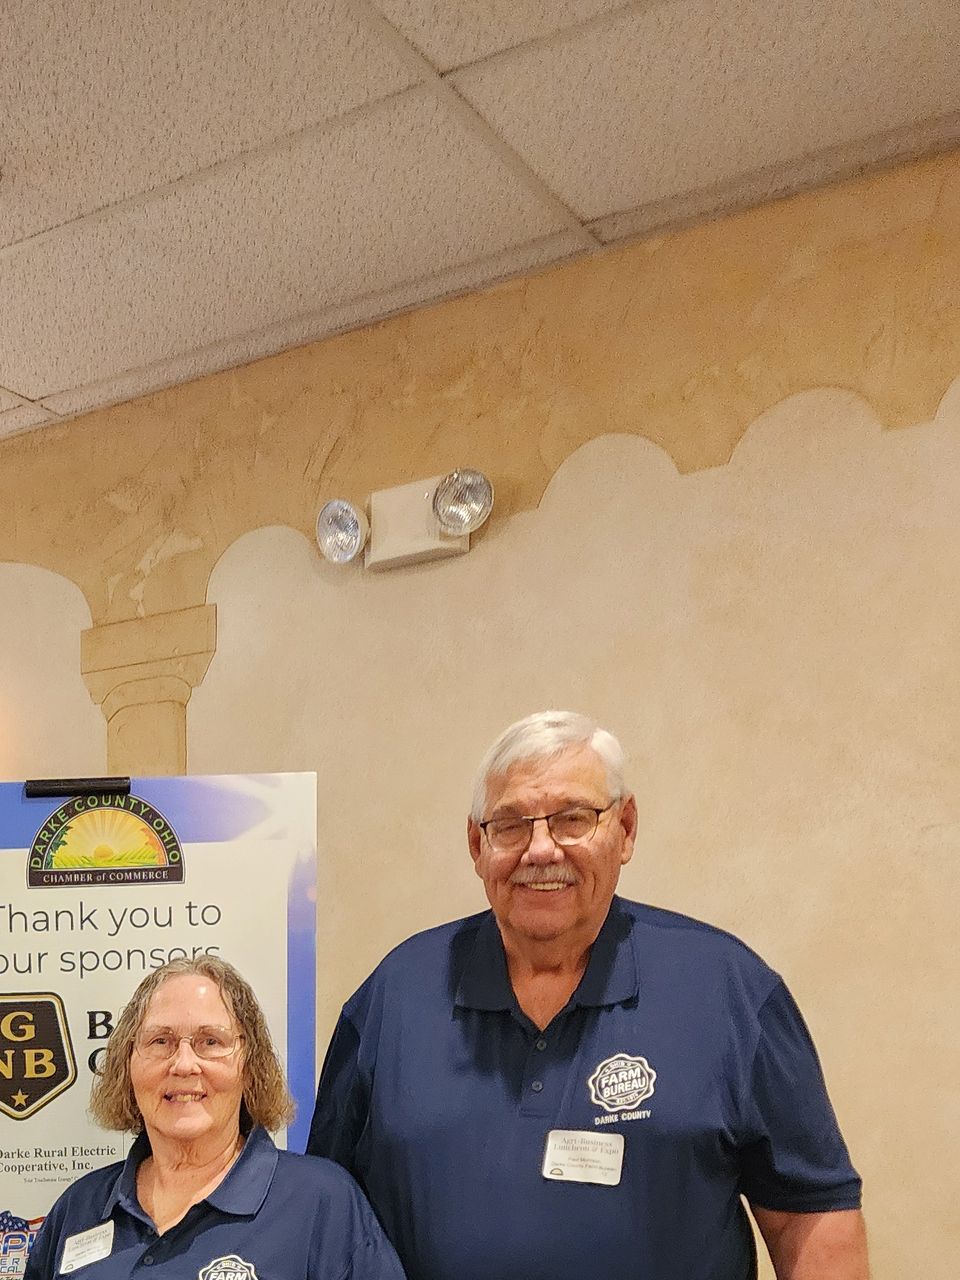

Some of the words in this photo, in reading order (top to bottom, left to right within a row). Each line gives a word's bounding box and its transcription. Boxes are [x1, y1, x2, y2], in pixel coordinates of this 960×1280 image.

[31, 810, 69, 868] DARKE
[74, 795, 150, 816] COUNTY
[153, 818, 180, 862] OHIO
[43, 872, 93, 883] CHAMBER
[96, 872, 106, 882] of
[109, 870, 169, 882] COMMERCE
[107, 905, 172, 937] you
[185, 901, 221, 926] to
[0, 1011, 36, 1042] G
[601, 1067, 641, 1088] FARM
[603, 1077, 646, 1098] BUREAU
[594, 1114, 619, 1125] DARKE
[621, 1110, 651, 1121] COUNTY
[33, 1146, 68, 1159] Rural
[71, 1145, 117, 1157] Electric
[72, 1159, 94, 1171] Inc.
